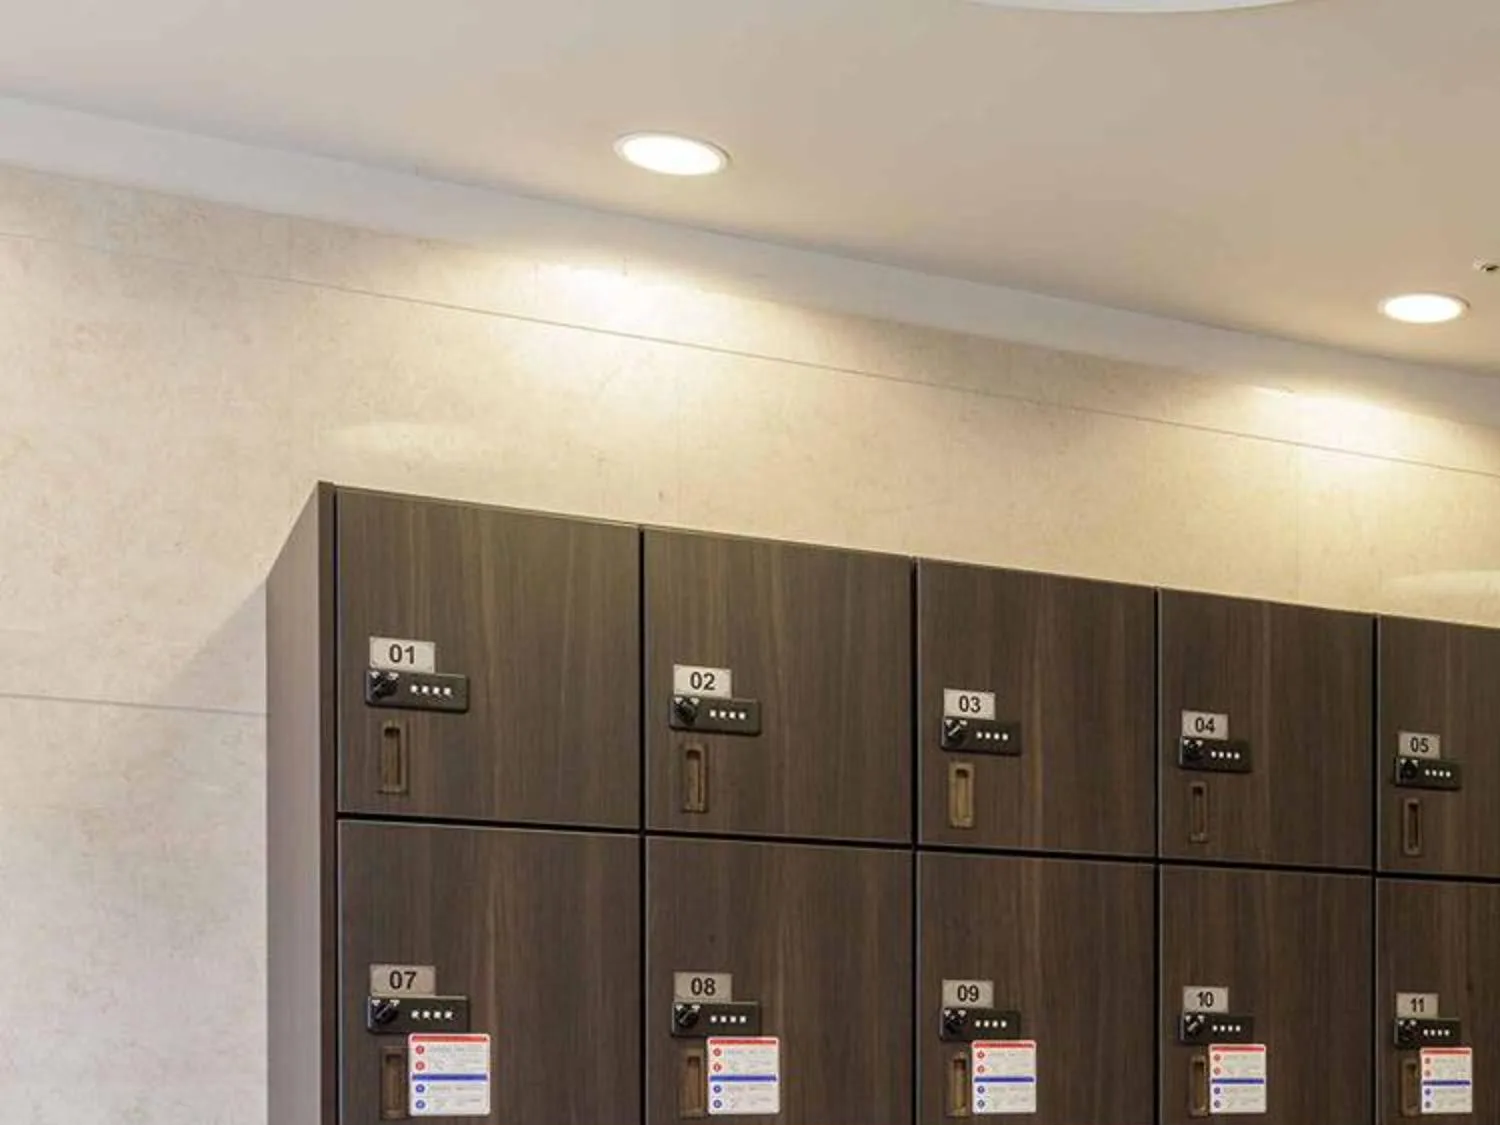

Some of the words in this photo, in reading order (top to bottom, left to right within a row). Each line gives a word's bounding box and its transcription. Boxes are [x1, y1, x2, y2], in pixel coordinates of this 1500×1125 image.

[389, 644, 414, 664] 01
[690, 672, 715, 690] 02
[959, 695, 981, 712] 03
[1195, 717, 1215, 733] 04
[1410, 737, 1429, 752] 05
[389, 971, 417, 989] 07
[691, 977, 715, 995] 08
[957, 984, 979, 1002] 09
[1198, 992, 1214, 1007] 10
[1411, 998, 1424, 1012] 11
